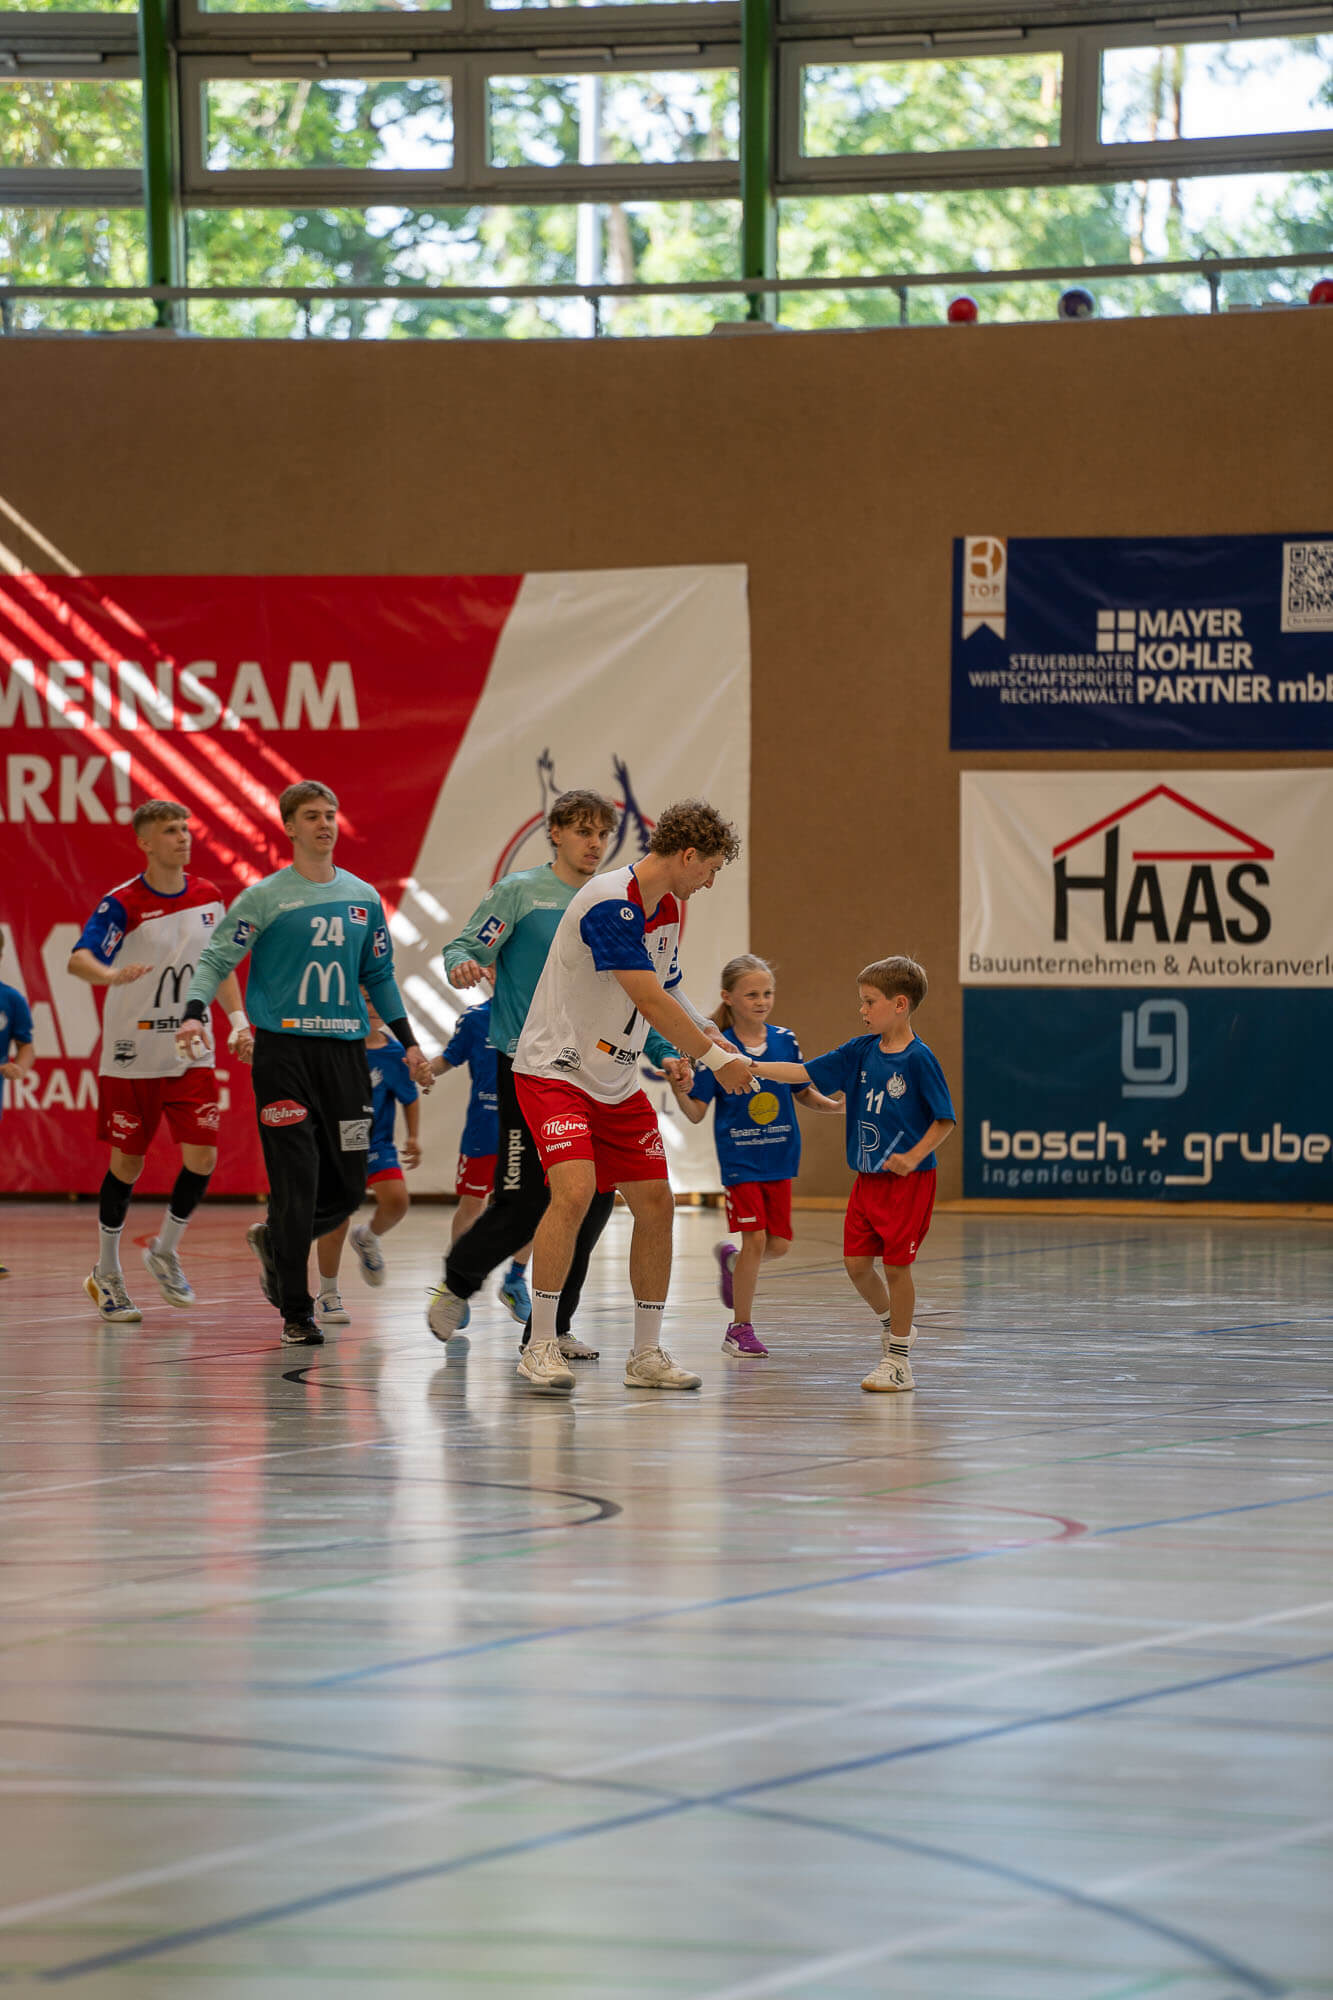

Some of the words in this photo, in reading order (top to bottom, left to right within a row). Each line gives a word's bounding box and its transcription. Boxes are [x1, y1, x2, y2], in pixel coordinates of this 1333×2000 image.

[1139, 609, 1244, 638] MAYER
[1009, 653, 1134, 671] STEUERBERATER
[1137, 641, 1254, 671] KOHLER
[0, 660, 360, 731] MEINSAM
[1137, 674, 1273, 704] PARTNER
[0, 752, 133, 825] RK!
[1053, 825, 1272, 945] HAAS
[310, 916, 345, 947] 24
[968, 952, 1156, 975] Bauunternehmen
[1164, 954, 1180, 975] &
[302, 1015, 361, 1032] stumpp
[865, 1087, 885, 1114] 11
[545, 1140, 573, 1153] Kempa
[981, 1119, 1127, 1161] bosch
[1142, 1129, 1167, 1156] +
[503, 1128, 526, 1191] Kempa
[982, 1163, 1163, 1188] ingenieurbüro
[535, 1290, 561, 1301] Kem
